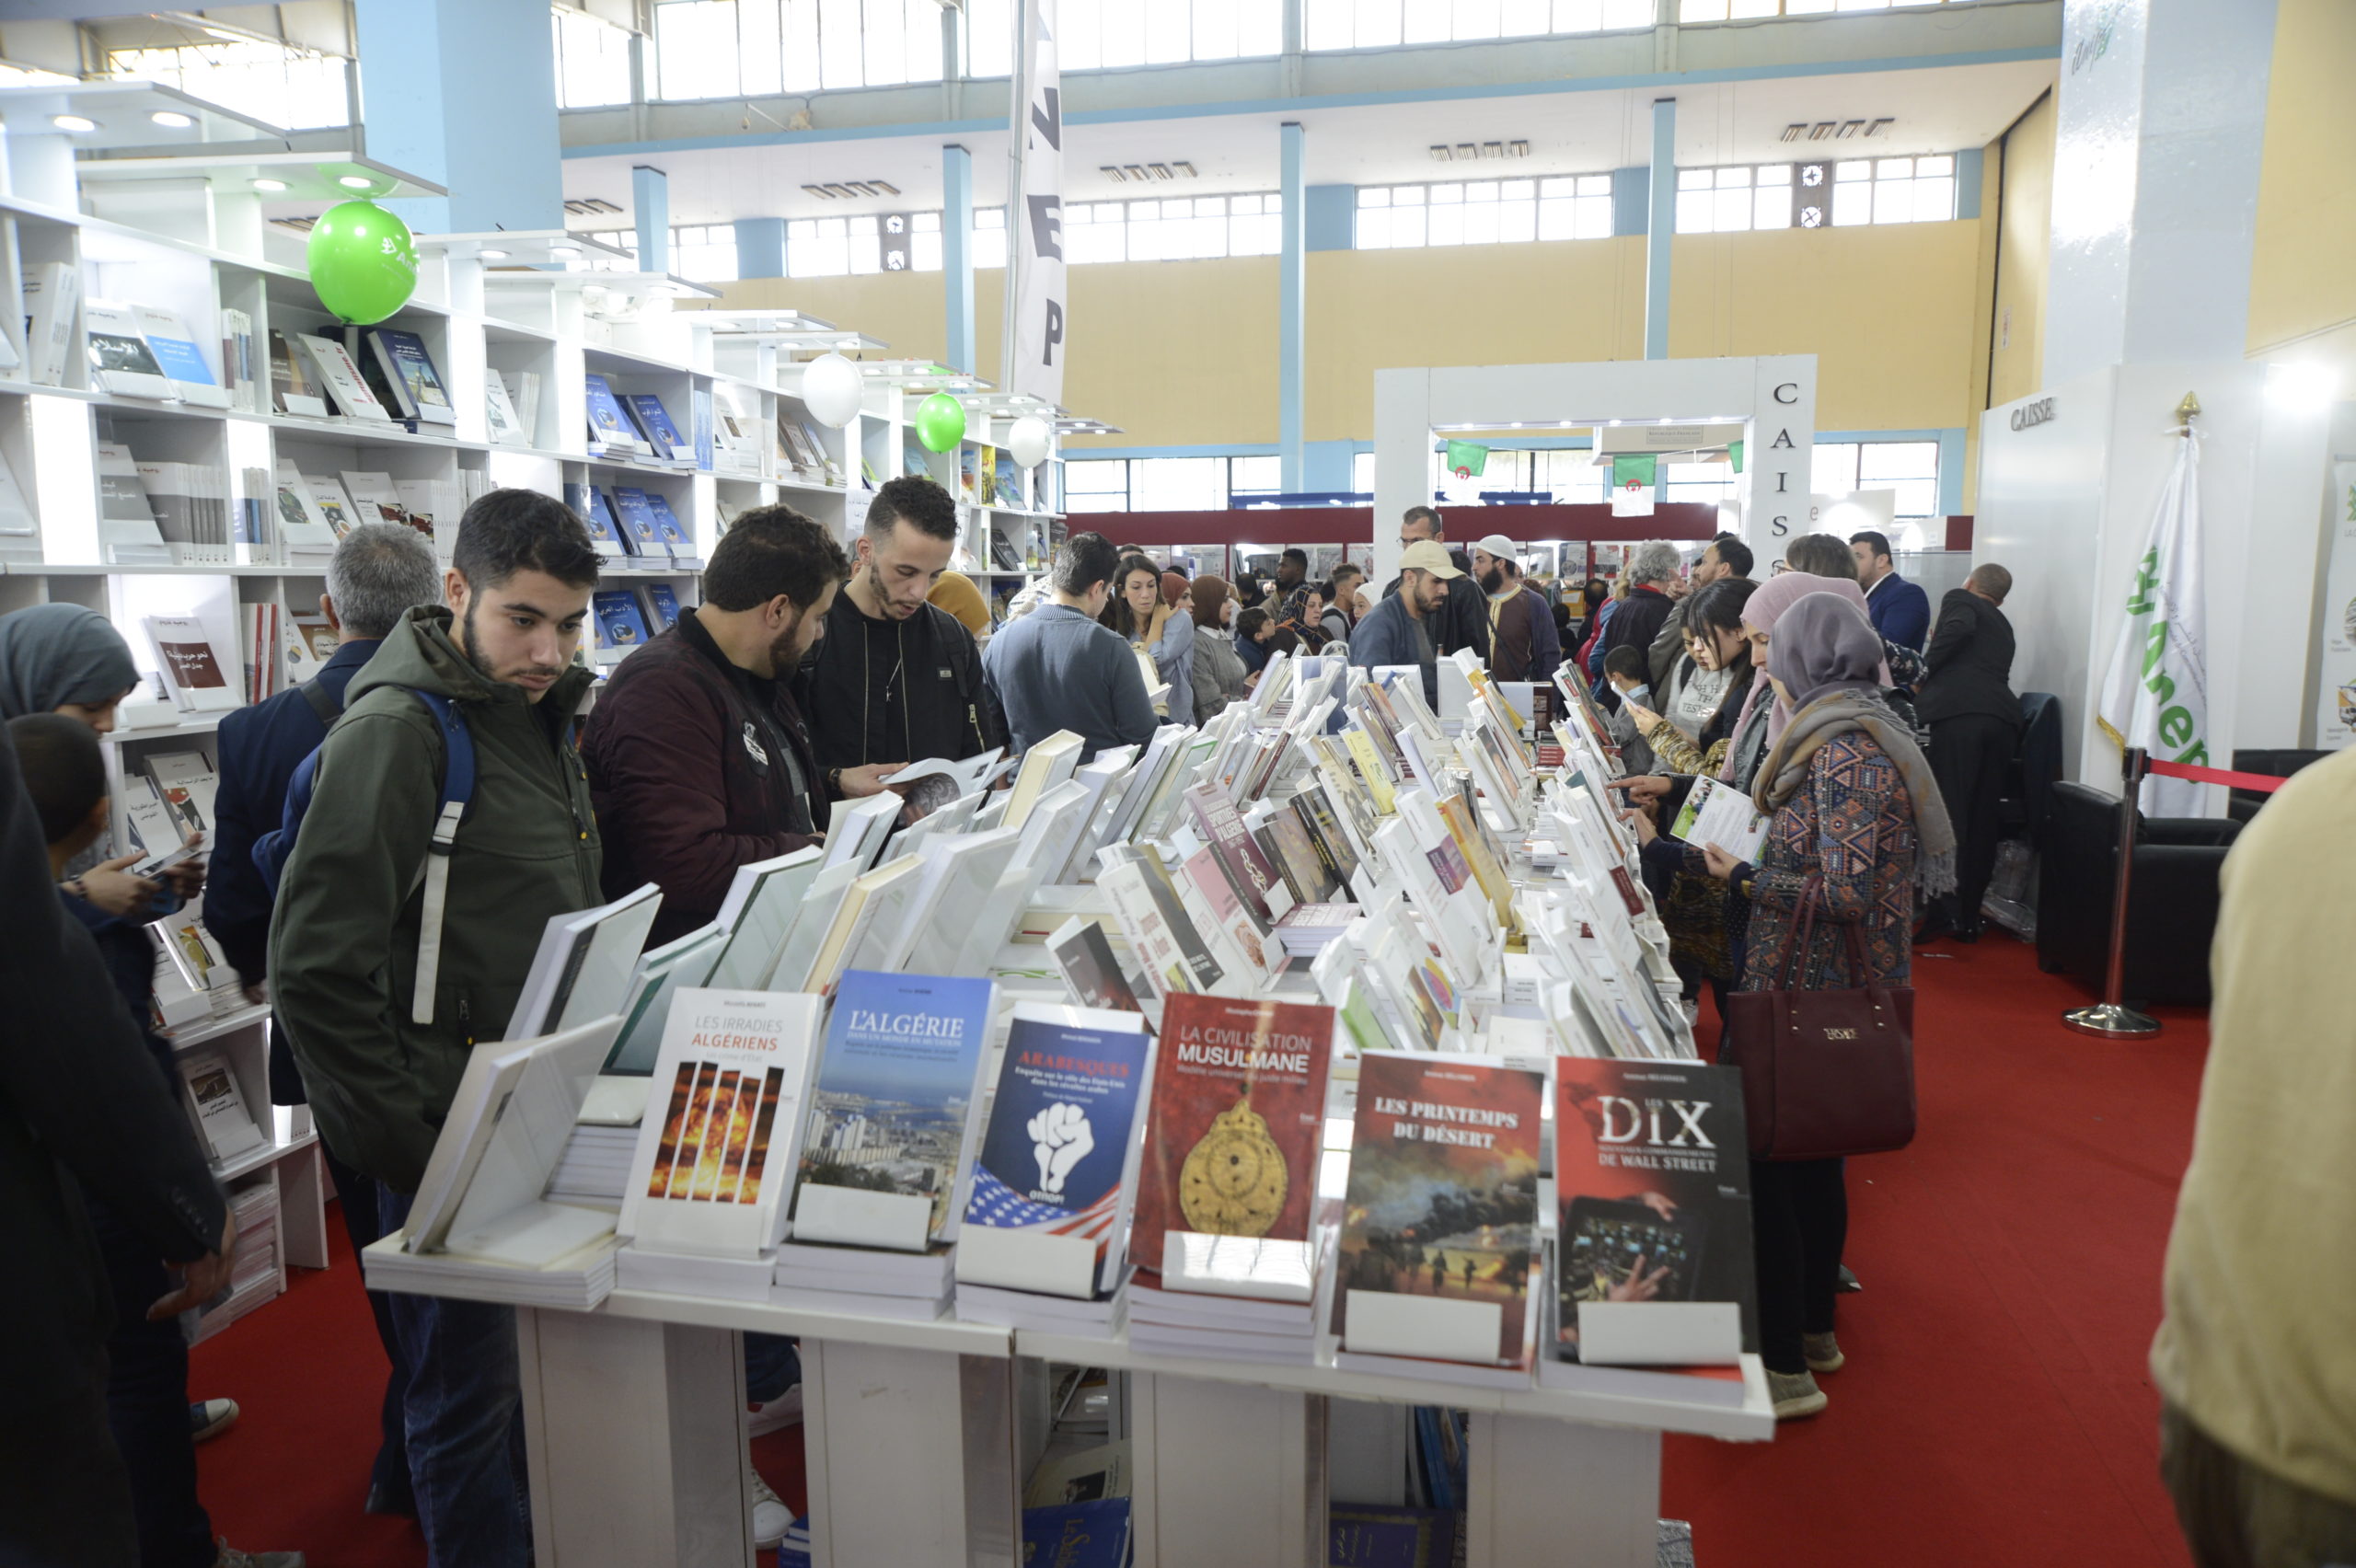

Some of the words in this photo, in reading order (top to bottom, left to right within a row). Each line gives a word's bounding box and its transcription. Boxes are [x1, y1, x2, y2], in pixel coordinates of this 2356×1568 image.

[2011, 397, 2056, 432] CAISSE
[695, 1015, 720, 1030] LES
[849, 1009, 964, 1039] L'ALGÉRIE
[691, 1032, 779, 1052] ALGÉRIENS
[1180, 1024, 1201, 1042] LA
[1203, 1027, 1313, 1053] CIVILISATION
[1177, 1043, 1311, 1074] MUSULMANE
[1374, 1095, 1408, 1116] LES
[1410, 1101, 1520, 1130] PRINTEMPS
[1392, 1121, 1420, 1141] DU
[1597, 1152, 1620, 1168] DE
[1620, 1154, 1662, 1170] WALL
[1662, 1156, 1718, 1173] STREET
